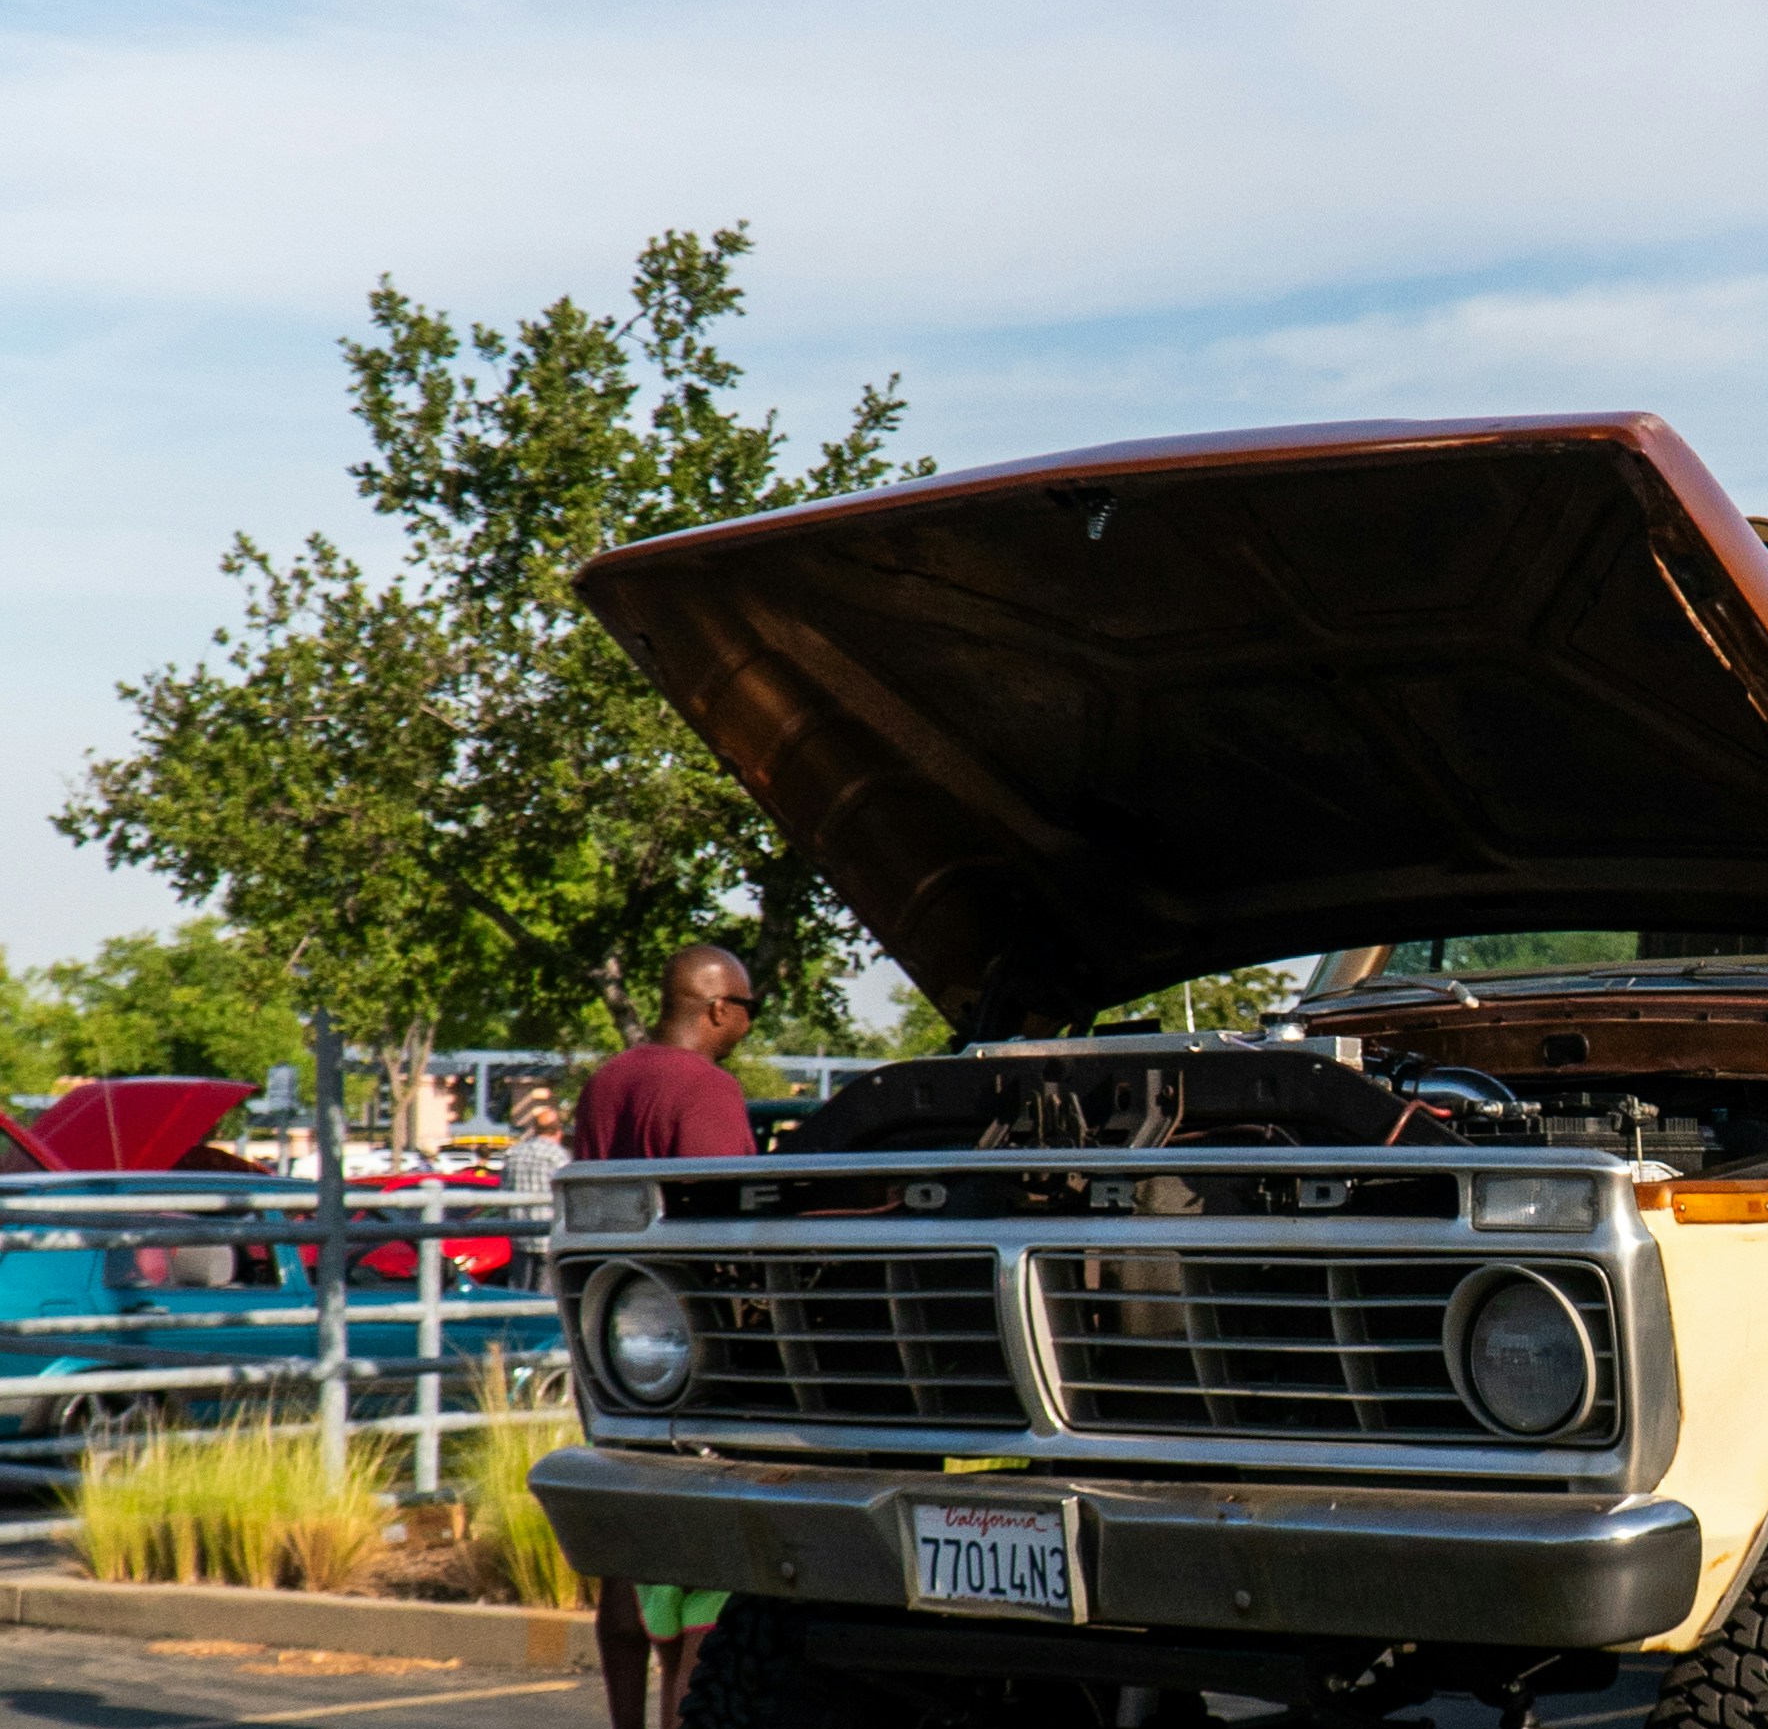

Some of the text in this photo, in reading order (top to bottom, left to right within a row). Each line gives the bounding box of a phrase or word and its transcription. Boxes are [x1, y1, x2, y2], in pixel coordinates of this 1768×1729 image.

[739, 1179, 1348, 1211] FORD
[944, 1504, 1047, 1537] California
[921, 1536, 1069, 1600] 77014N3
